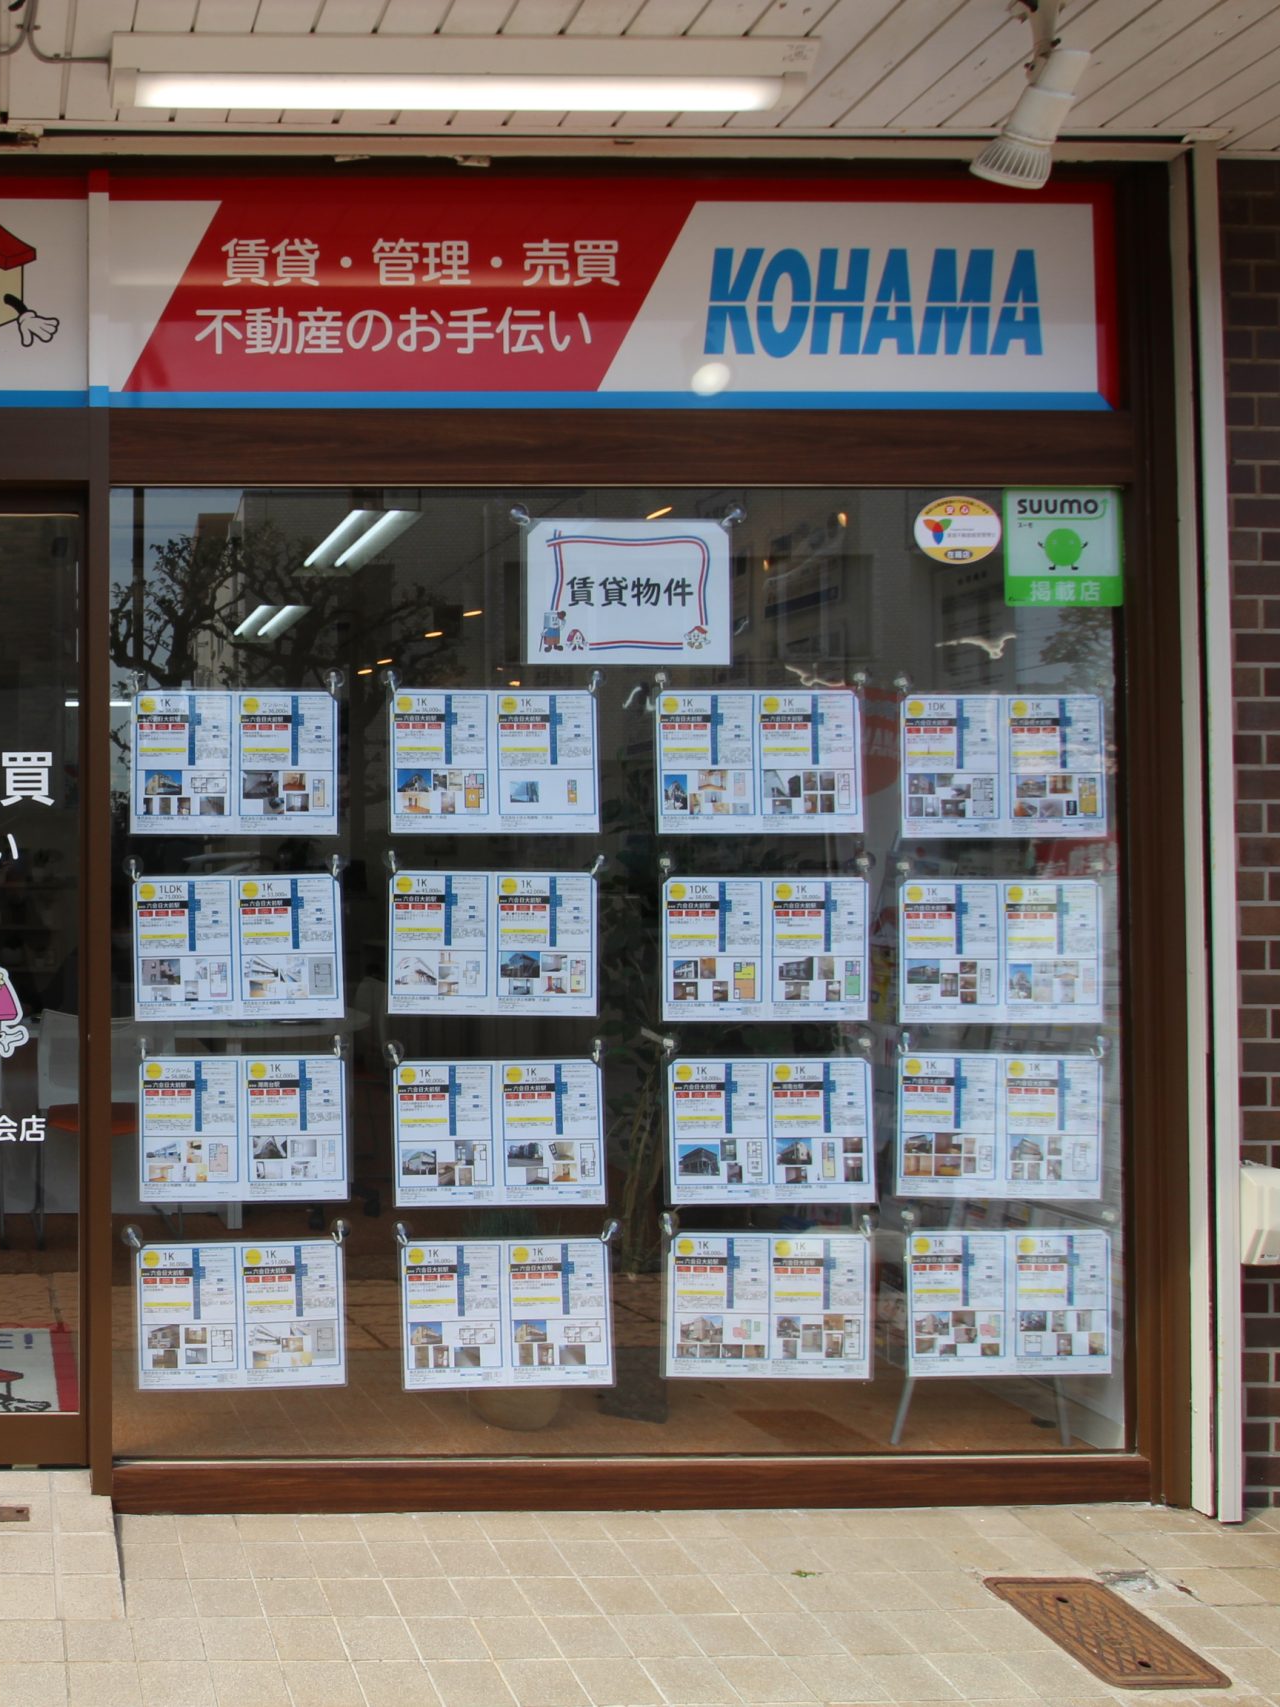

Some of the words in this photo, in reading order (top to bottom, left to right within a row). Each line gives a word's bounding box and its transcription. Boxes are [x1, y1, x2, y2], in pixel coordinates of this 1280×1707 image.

[221, 238, 620, 287] 賃貸・管理・売買
[703, 248, 1043, 358] KOHAMA
[195, 306, 592, 354] 不動産のお手伝い
[566, 576, 694, 607] 賃貸物件
[1030, 581, 1101, 602] 掲載店
[160, 699, 171, 708] 1K
[416, 698, 427, 706] 1K
[520, 698, 532, 706] 1K
[682, 699, 693, 707] 1K
[262, 883, 273, 891] 1K
[416, 879, 427, 887] 1K
[521, 880, 532, 888] 1K
[159, 885, 182, 894] 1LDK
[689, 885, 708, 894] 1DK
[796, 885, 807, 894] 1K
[270, 1064, 281, 1072] 1K
[526, 1068, 537, 1076] 1K
[696, 1066, 707, 1075] 1K
[795, 1066, 805, 1074] 1K
[420, 1069, 431, 1077] 1K
[698, 1241, 709, 1250] 1K
[795, 1242, 805, 1250] 1K
[163, 1252, 175, 1260] 1K
[265, 1250, 277, 1258] 1K
[428, 1249, 439, 1258] 1K
[533, 1248, 543, 1256] 1K
